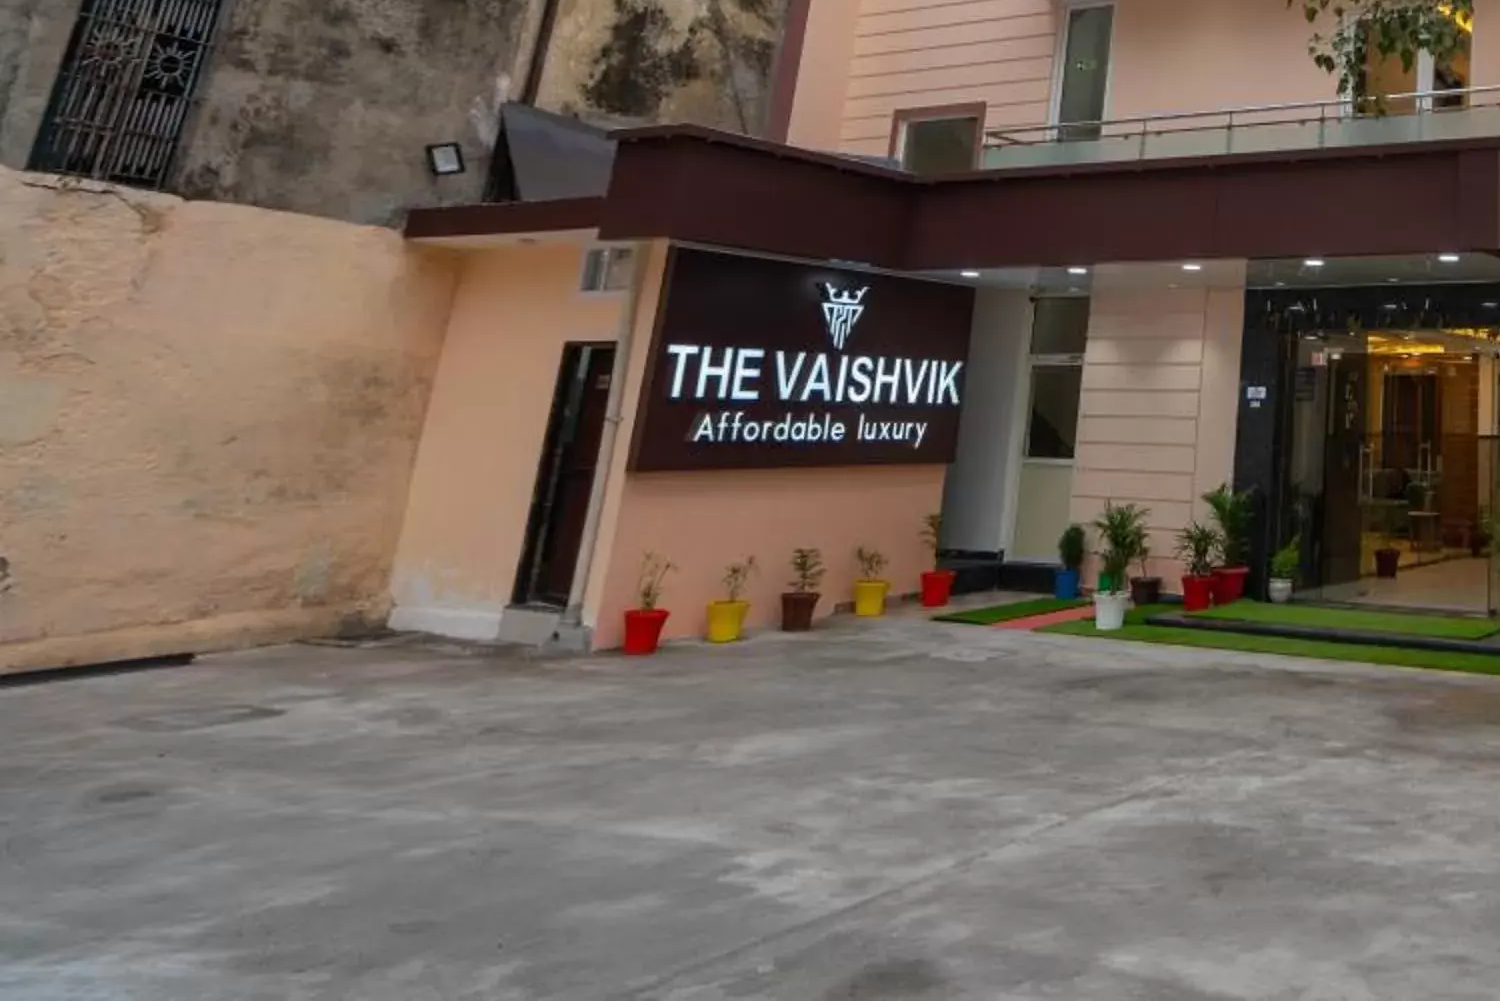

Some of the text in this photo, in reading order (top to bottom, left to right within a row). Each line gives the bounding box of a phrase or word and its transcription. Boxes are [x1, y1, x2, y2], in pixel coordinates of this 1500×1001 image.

[667, 344, 963, 405] THE VAISHVIK
[692, 412, 927, 448] Affordable luxury
